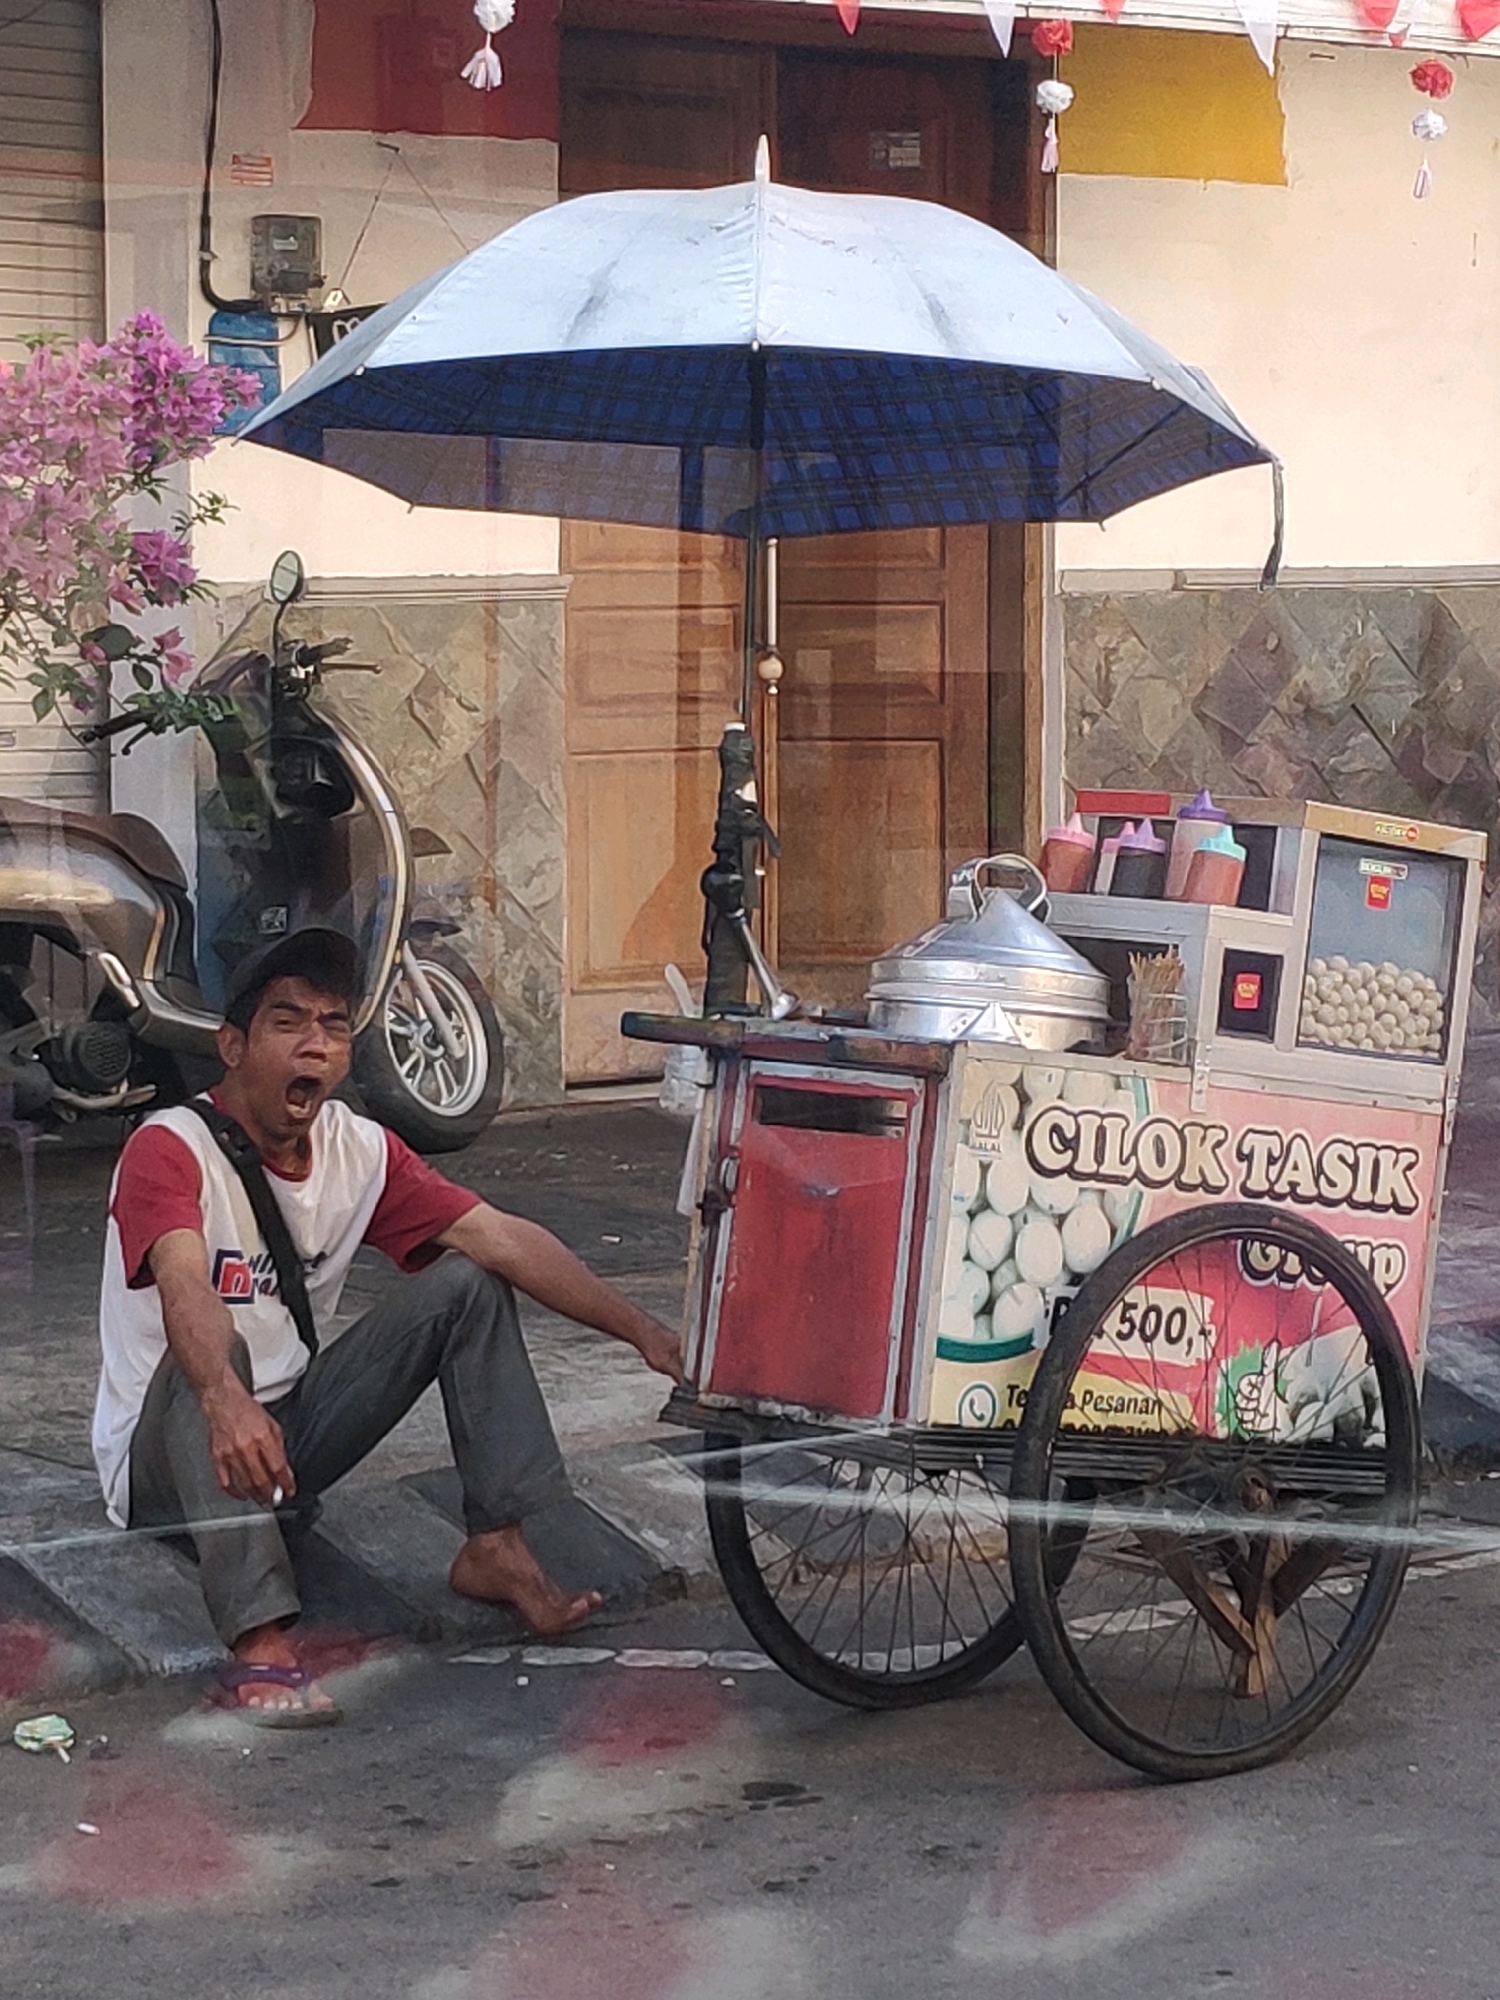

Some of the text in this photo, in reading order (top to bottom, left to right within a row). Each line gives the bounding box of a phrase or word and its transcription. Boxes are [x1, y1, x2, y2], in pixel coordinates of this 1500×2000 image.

[1026, 1106, 1420, 1214] CILOK TASIK
[1241, 1238, 1406, 1296] Grup
[1006, 1384, 1162, 1416] Tea Pesanan
